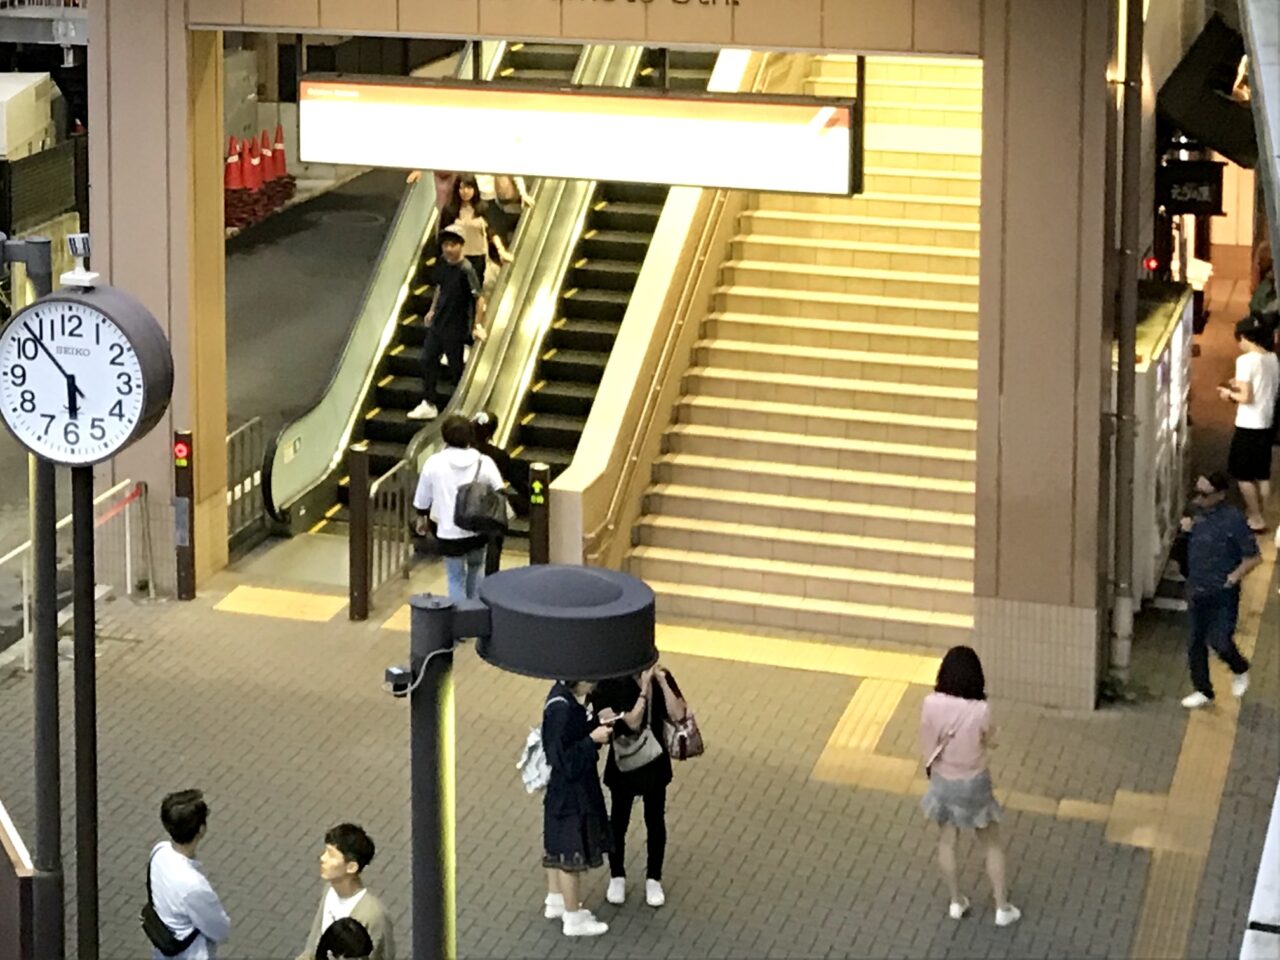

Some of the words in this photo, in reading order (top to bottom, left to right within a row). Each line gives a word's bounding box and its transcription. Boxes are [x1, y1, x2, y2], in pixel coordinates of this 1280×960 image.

[61, 314, 83, 337] 12
[17, 337, 38, 361] 10
[56, 346, 90, 357] SEIKO
[109, 343, 125, 366] 2
[10, 364, 26, 387] 9
[116, 372, 132, 395] 3
[20, 390, 36, 413] 8
[109, 399, 125, 422] 4
[40, 413, 56, 436] 7
[64, 422, 80, 445] 6
[90, 418, 106, 441] 5
